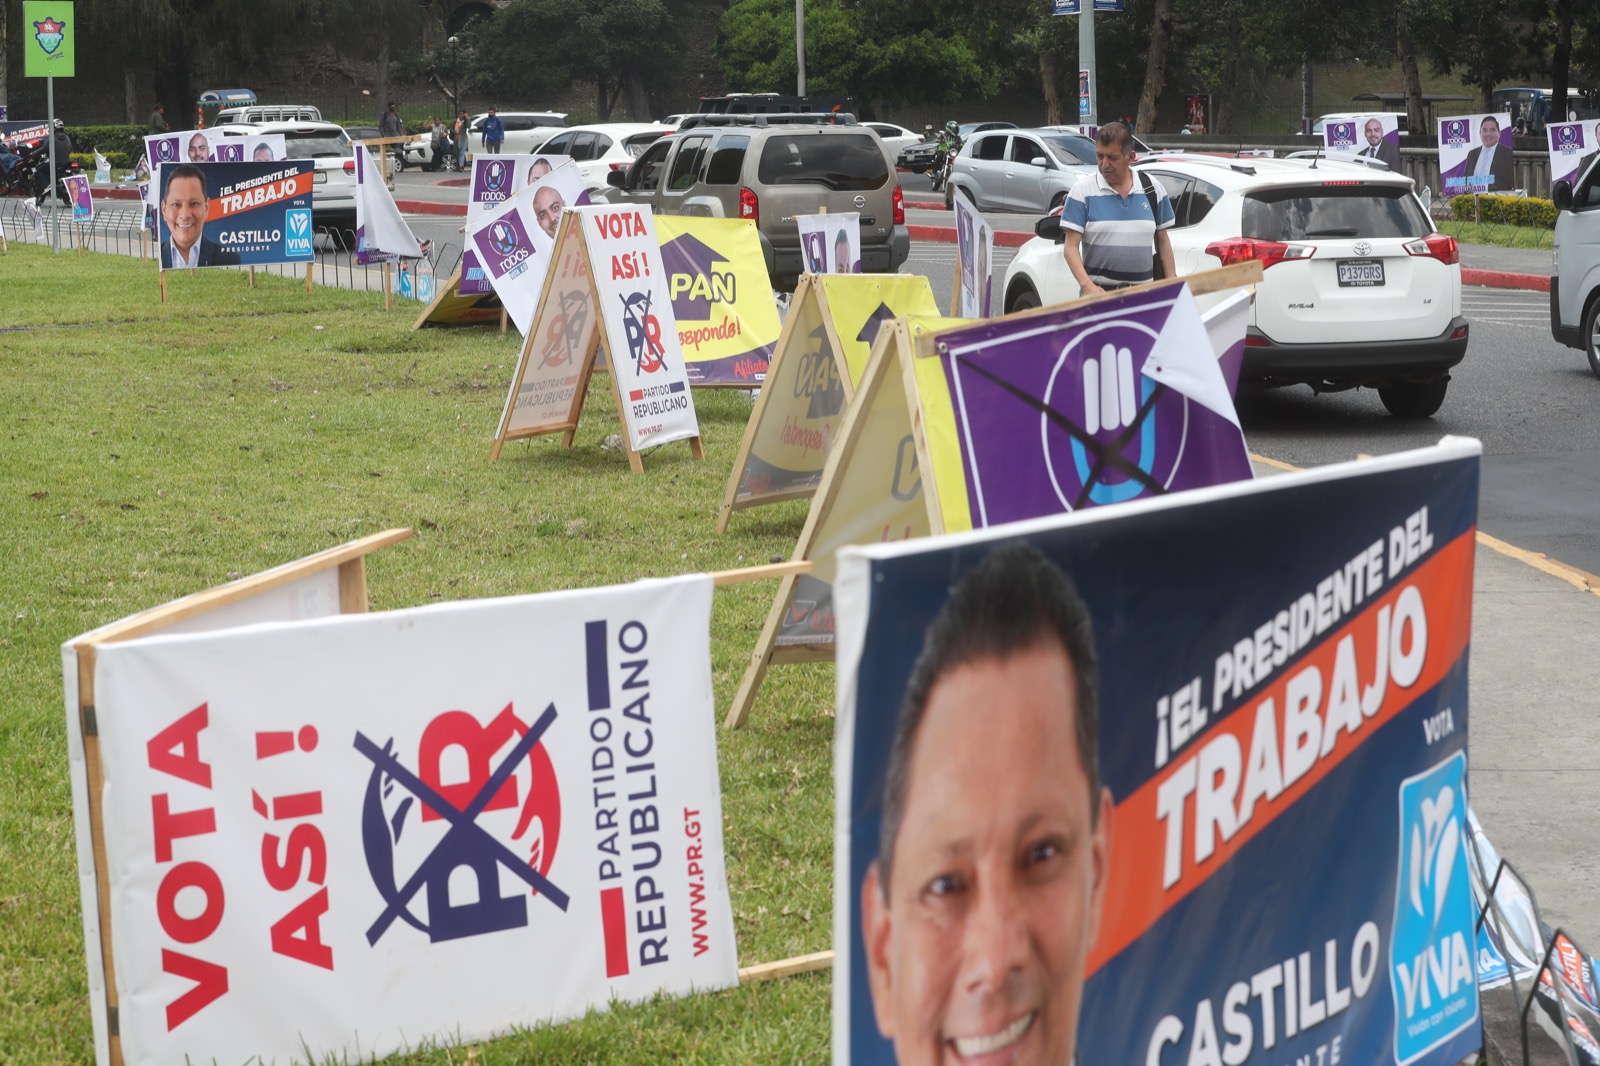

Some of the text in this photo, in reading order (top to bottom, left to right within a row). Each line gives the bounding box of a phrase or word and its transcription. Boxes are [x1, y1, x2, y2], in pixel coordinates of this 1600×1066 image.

[220, 186, 234, 197] ¡EL
[235, 173, 283, 191] PRESIDENTE
[284, 167, 299, 179] DEL
[221, 179, 297, 214] TRABAJO
[480, 191, 506, 201] TODOS
[219, 229, 281, 244] CASTILLO
[594, 211, 648, 240] VOTA
[221, 245, 270, 253] PRESIDENTE
[287, 238, 310, 249] VIVA
[499, 247, 529, 272] TODOS
[670, 272, 736, 304] PAN
[1340, 266, 1381, 280] P137GRS
[632, 395, 688, 419] REPUBLICANO
[642, 384, 669, 400] PARTIDO
[1155, 506, 1434, 768] ¡EL PRESIDENTE DEL
[1156, 585, 1427, 890] TRABAJO
[1423, 708, 1454, 745] VOTA
[589, 716, 622, 881] PARTIDO
[617, 620, 669, 966] REPUBLICANO
[146, 701, 229, 1033] VOTA
[683, 806, 709, 957] WWW.PR.GT
[1397, 930, 1474, 1018] VIVA
[1146, 921, 1379, 1066] CASTILLO
